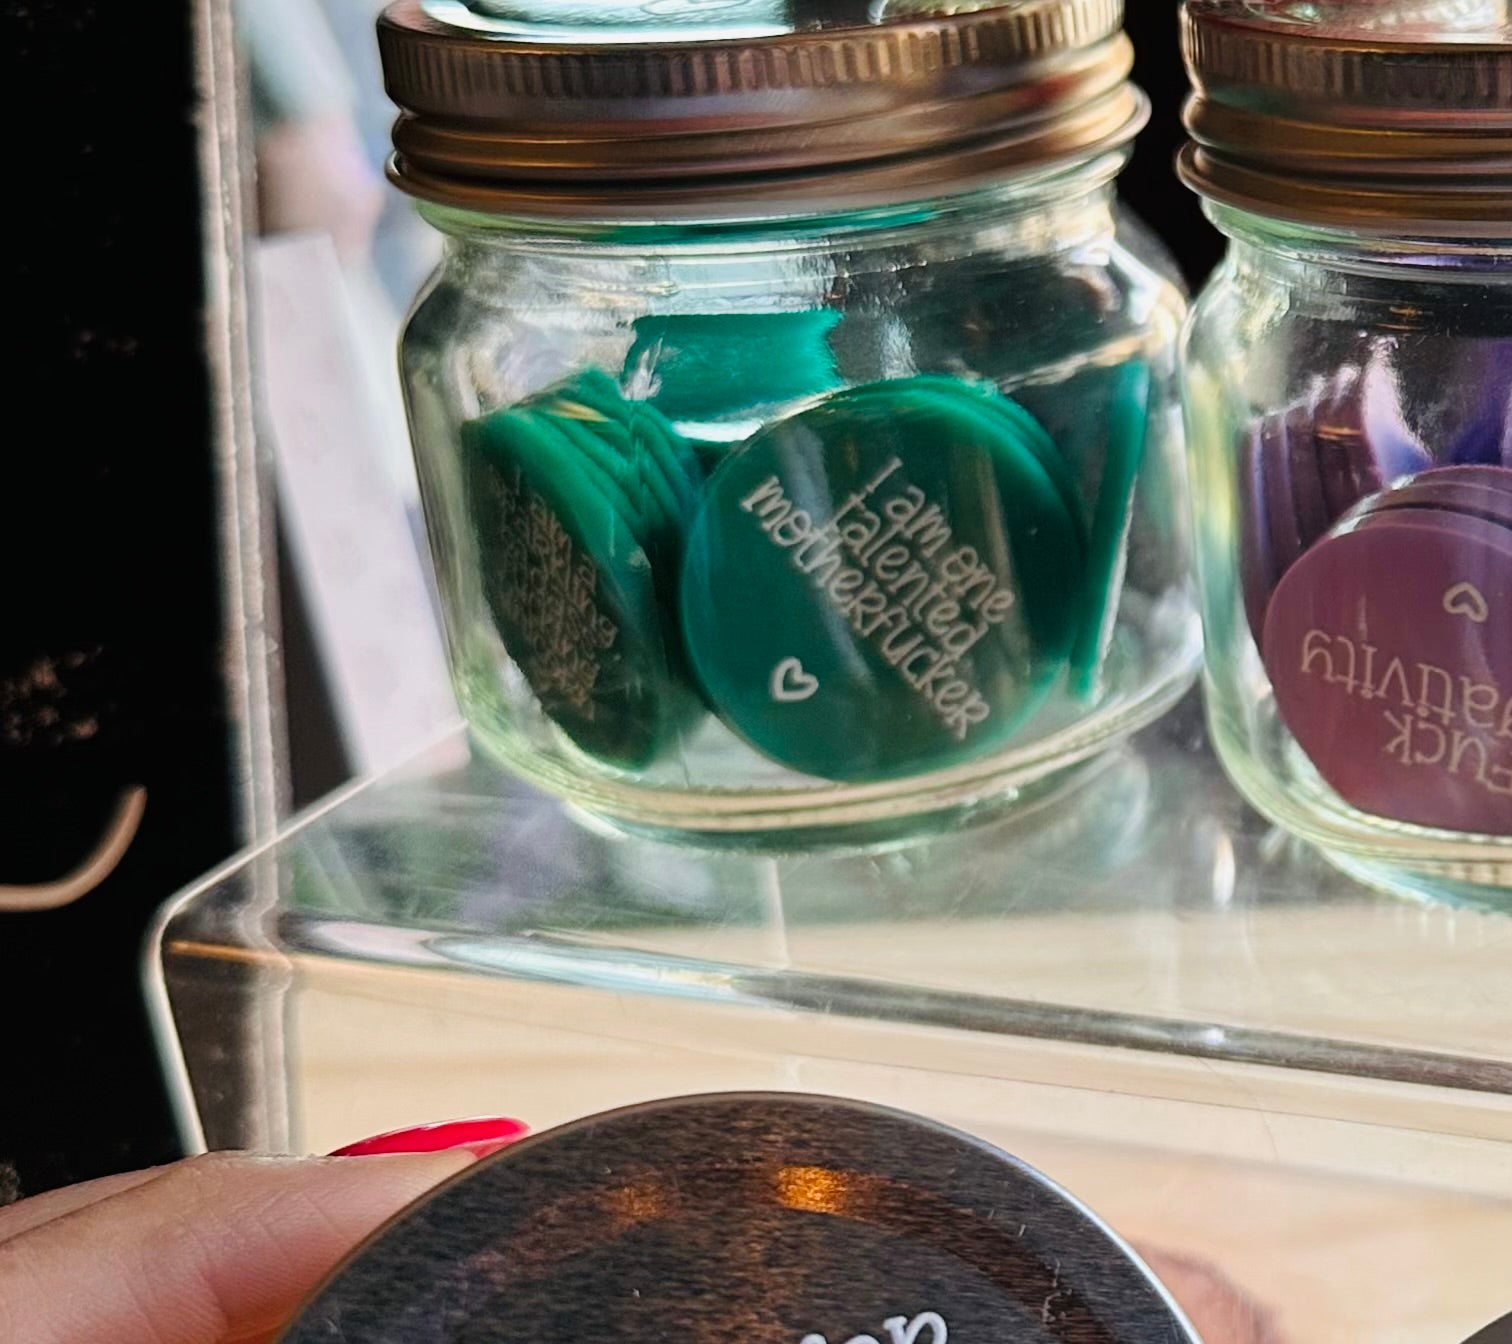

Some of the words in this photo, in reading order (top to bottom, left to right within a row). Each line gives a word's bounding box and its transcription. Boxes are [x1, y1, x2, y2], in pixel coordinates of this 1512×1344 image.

[832, 492, 990, 661] talented
[866, 456, 904, 494] I
[885, 485, 952, 559] am
[941, 544, 1016, 624] one
